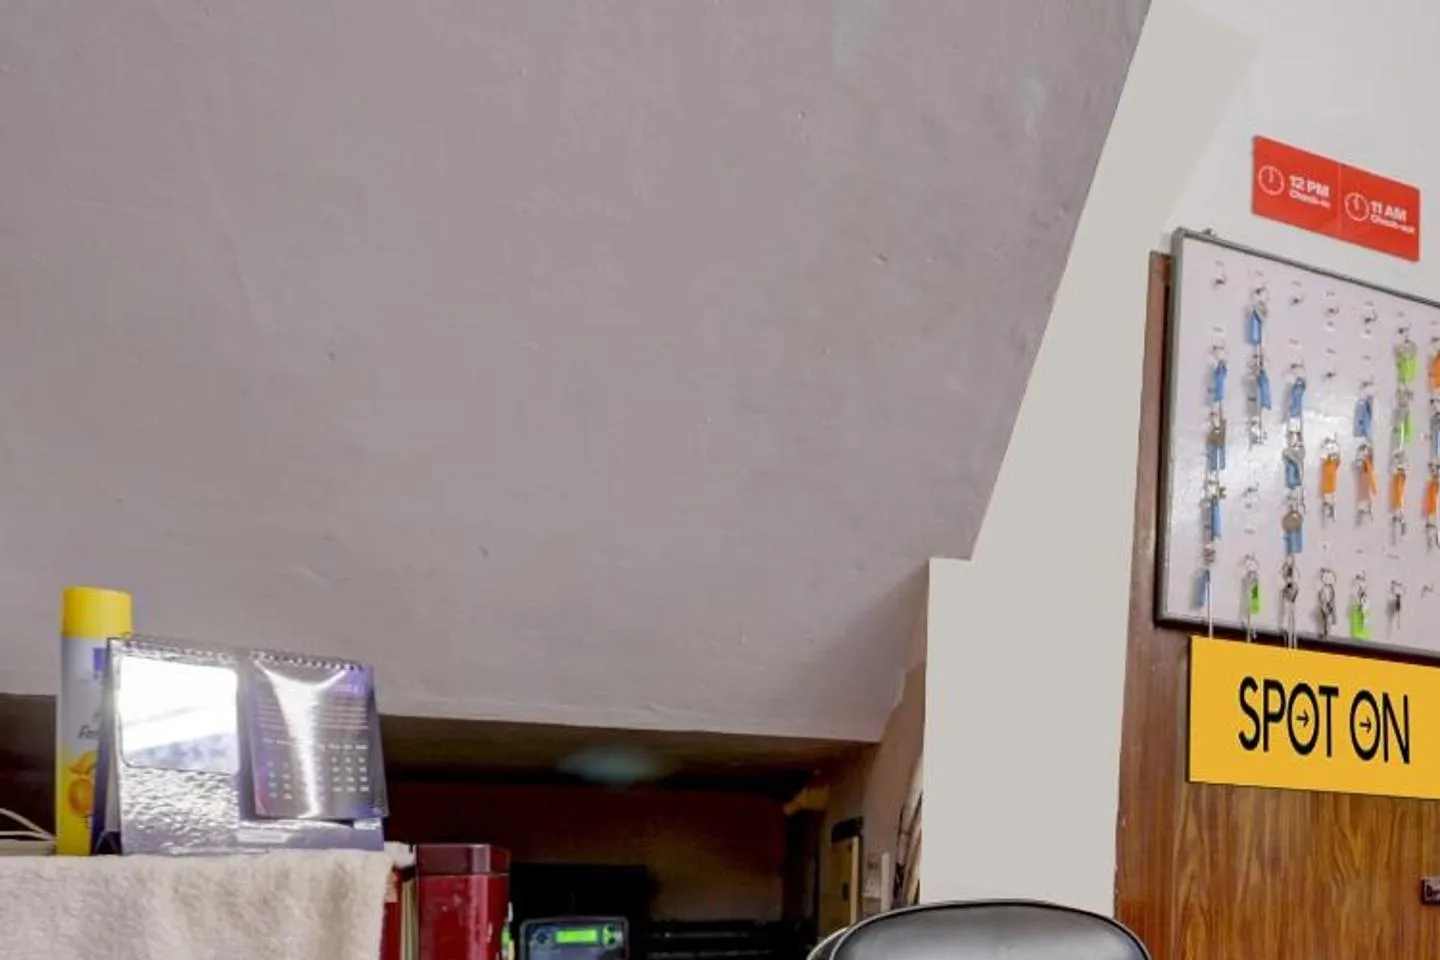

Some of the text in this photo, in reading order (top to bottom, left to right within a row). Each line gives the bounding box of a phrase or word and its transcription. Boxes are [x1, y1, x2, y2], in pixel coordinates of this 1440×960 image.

[1289, 174, 1330, 198] 12 PM
[1370, 200, 1407, 223] 11 AM
[1238, 676, 1411, 764] SPOT ON
